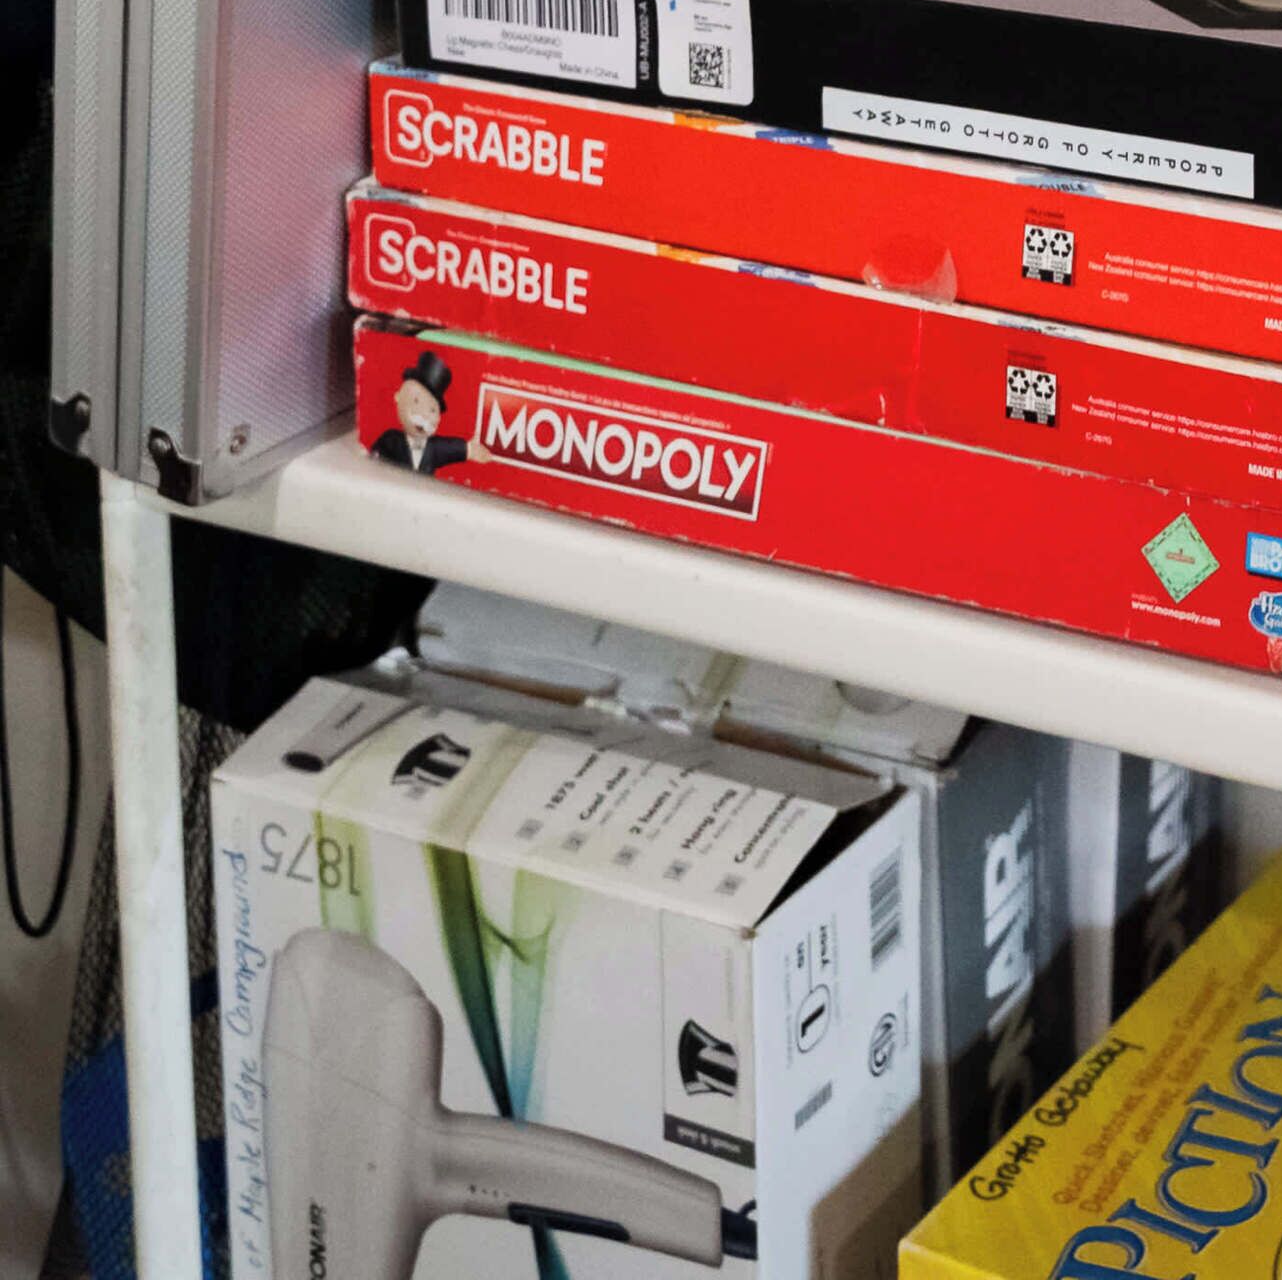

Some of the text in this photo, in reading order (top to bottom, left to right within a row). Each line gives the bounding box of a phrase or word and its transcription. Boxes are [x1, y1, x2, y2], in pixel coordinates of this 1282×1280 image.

[397, 104, 606, 186] SCRABBLE
[852, 107, 1223, 179] PROPERTY OF GROTTO GETAWAY
[378, 229, 589, 315] SCRABBLE
[484, 400, 757, 503] MONOPOLY
[1248, 463, 1275, 479] MADE
[1131, 600, 1221, 628] www.monopoly.com
[260, 821, 362, 896] 1875
[967, 1130, 1047, 1203] Grotto
[309, 1202, 327, 1280] ONAIR
